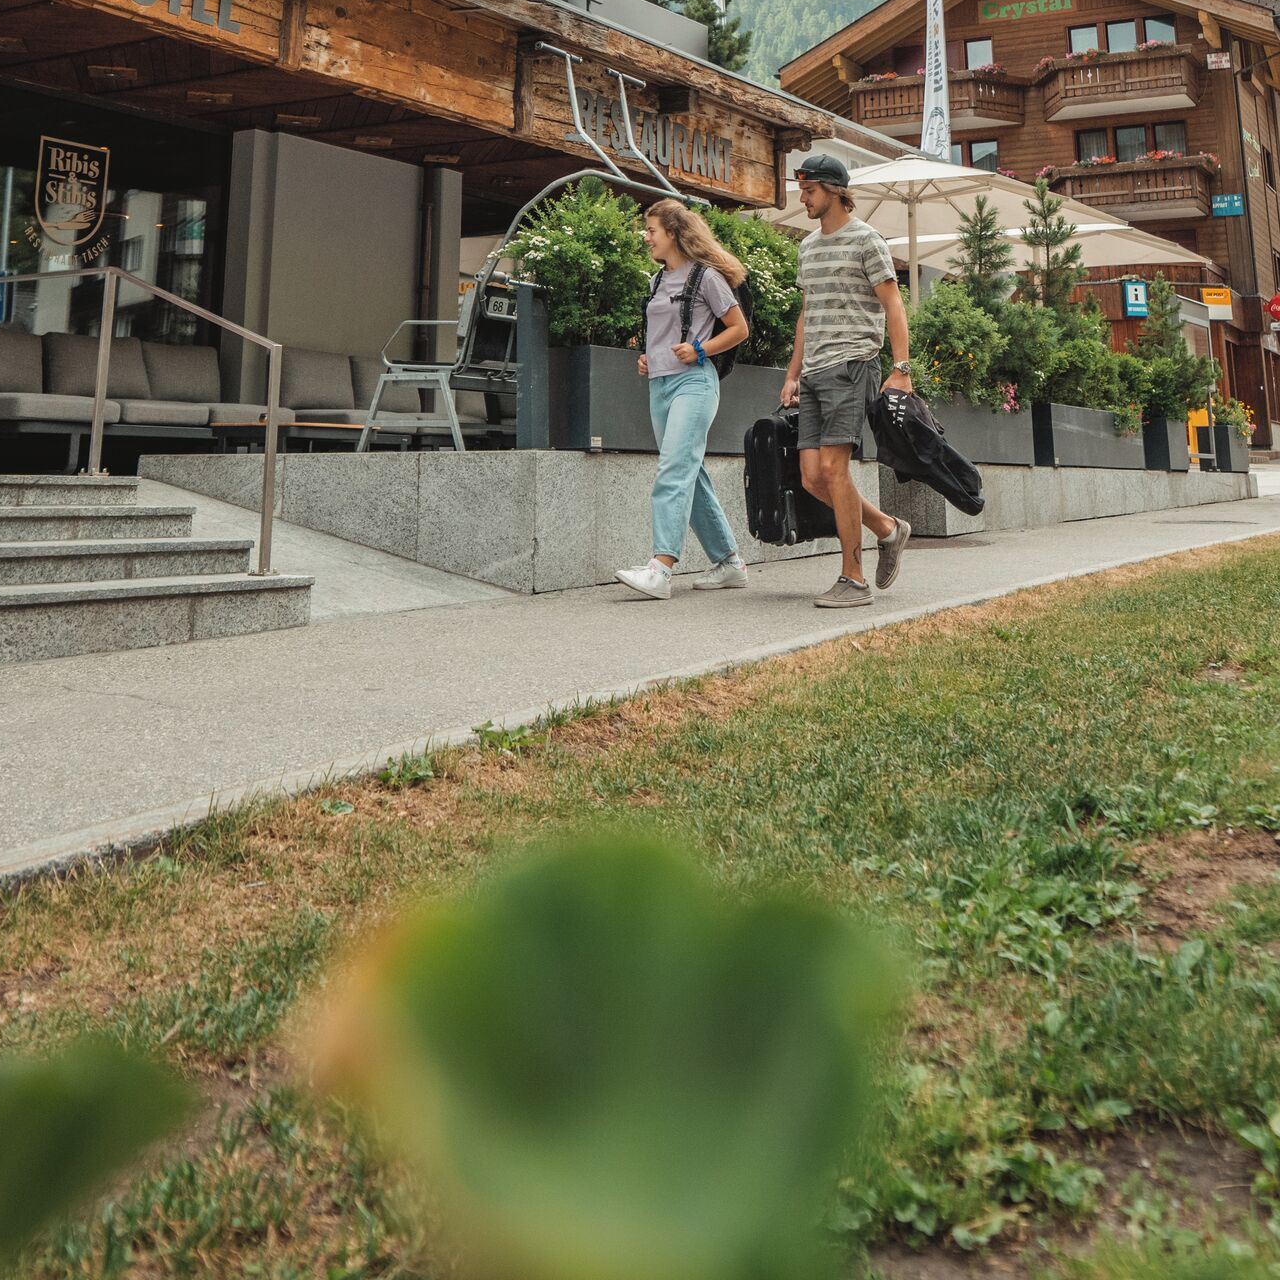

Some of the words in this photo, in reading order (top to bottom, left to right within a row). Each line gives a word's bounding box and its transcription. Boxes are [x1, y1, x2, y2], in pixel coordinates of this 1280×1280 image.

[576, 87, 733, 184] RESTAURANT
[48, 146, 100, 179] Ribis
[67, 171, 78, 184] &
[45, 180, 97, 209] Stibis
[24, 226, 79, 266] RESTRAT
[493, 301, 504, 313] 68
[897, 405, 907, 428] BIK
